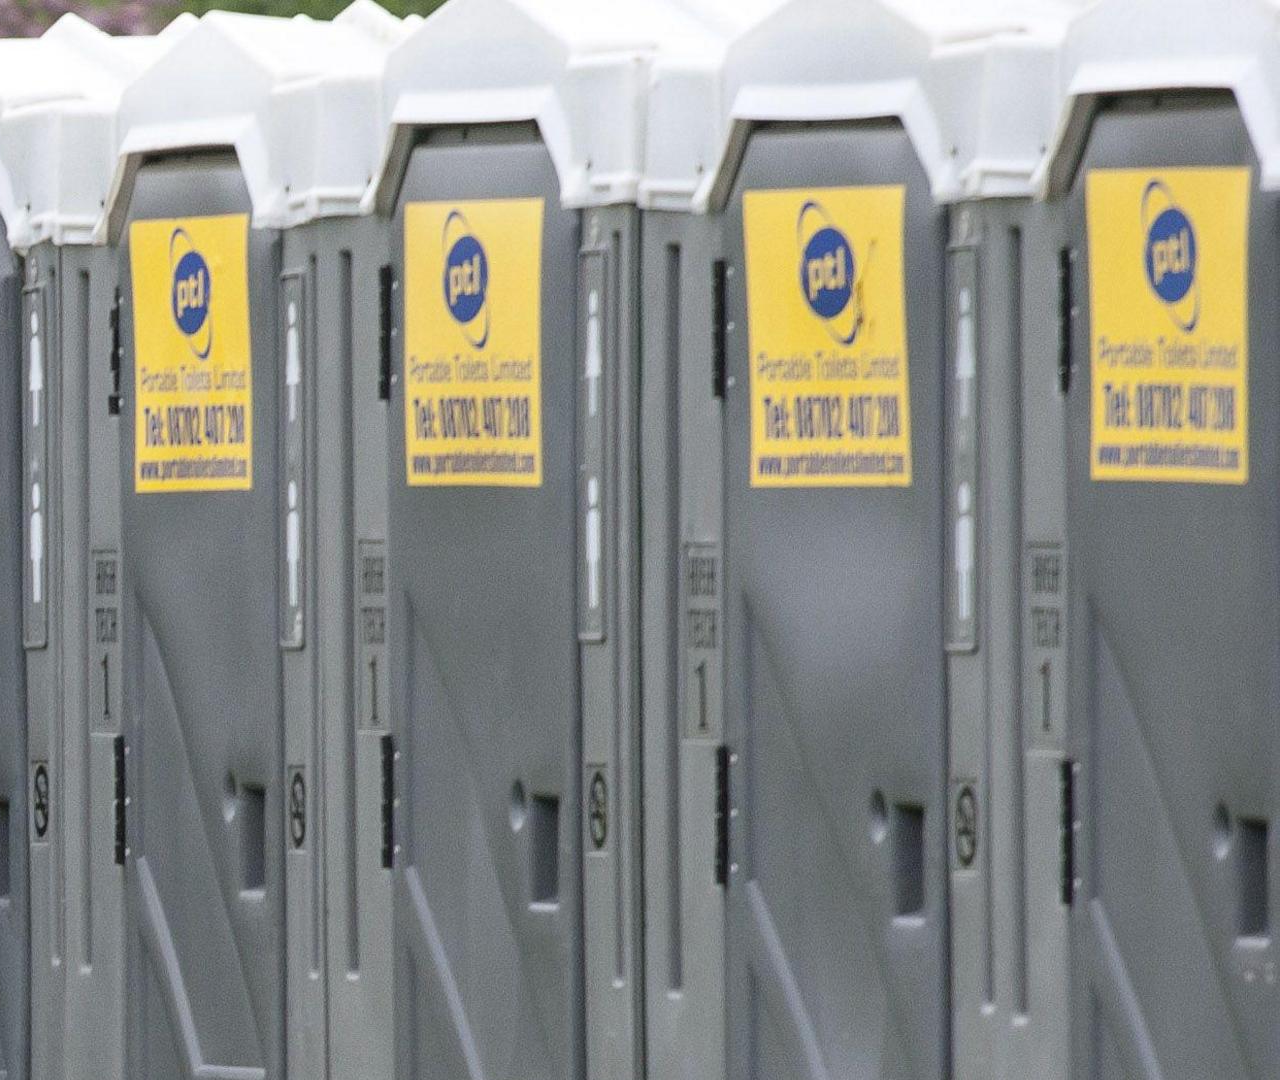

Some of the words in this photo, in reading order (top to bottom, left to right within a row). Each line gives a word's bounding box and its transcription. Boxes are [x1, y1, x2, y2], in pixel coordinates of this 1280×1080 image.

[808, 246, 846, 301] ptl
[1152, 228, 1190, 286] ptl
[176, 269, 204, 320] ptl
[450, 253, 481, 304] ptl
[181, 366, 211, 392] Toilets
[214, 366, 245, 390] Limited
[411, 356, 451, 383] Portable
[454, 355, 489, 383] Toilets
[491, 355, 531, 382] Limited
[758, 352, 810, 381] Portable
[815, 351, 858, 380] Toilets
[145, 406, 165, 446] Tel:
[415, 397, 436, 438] Tel:
